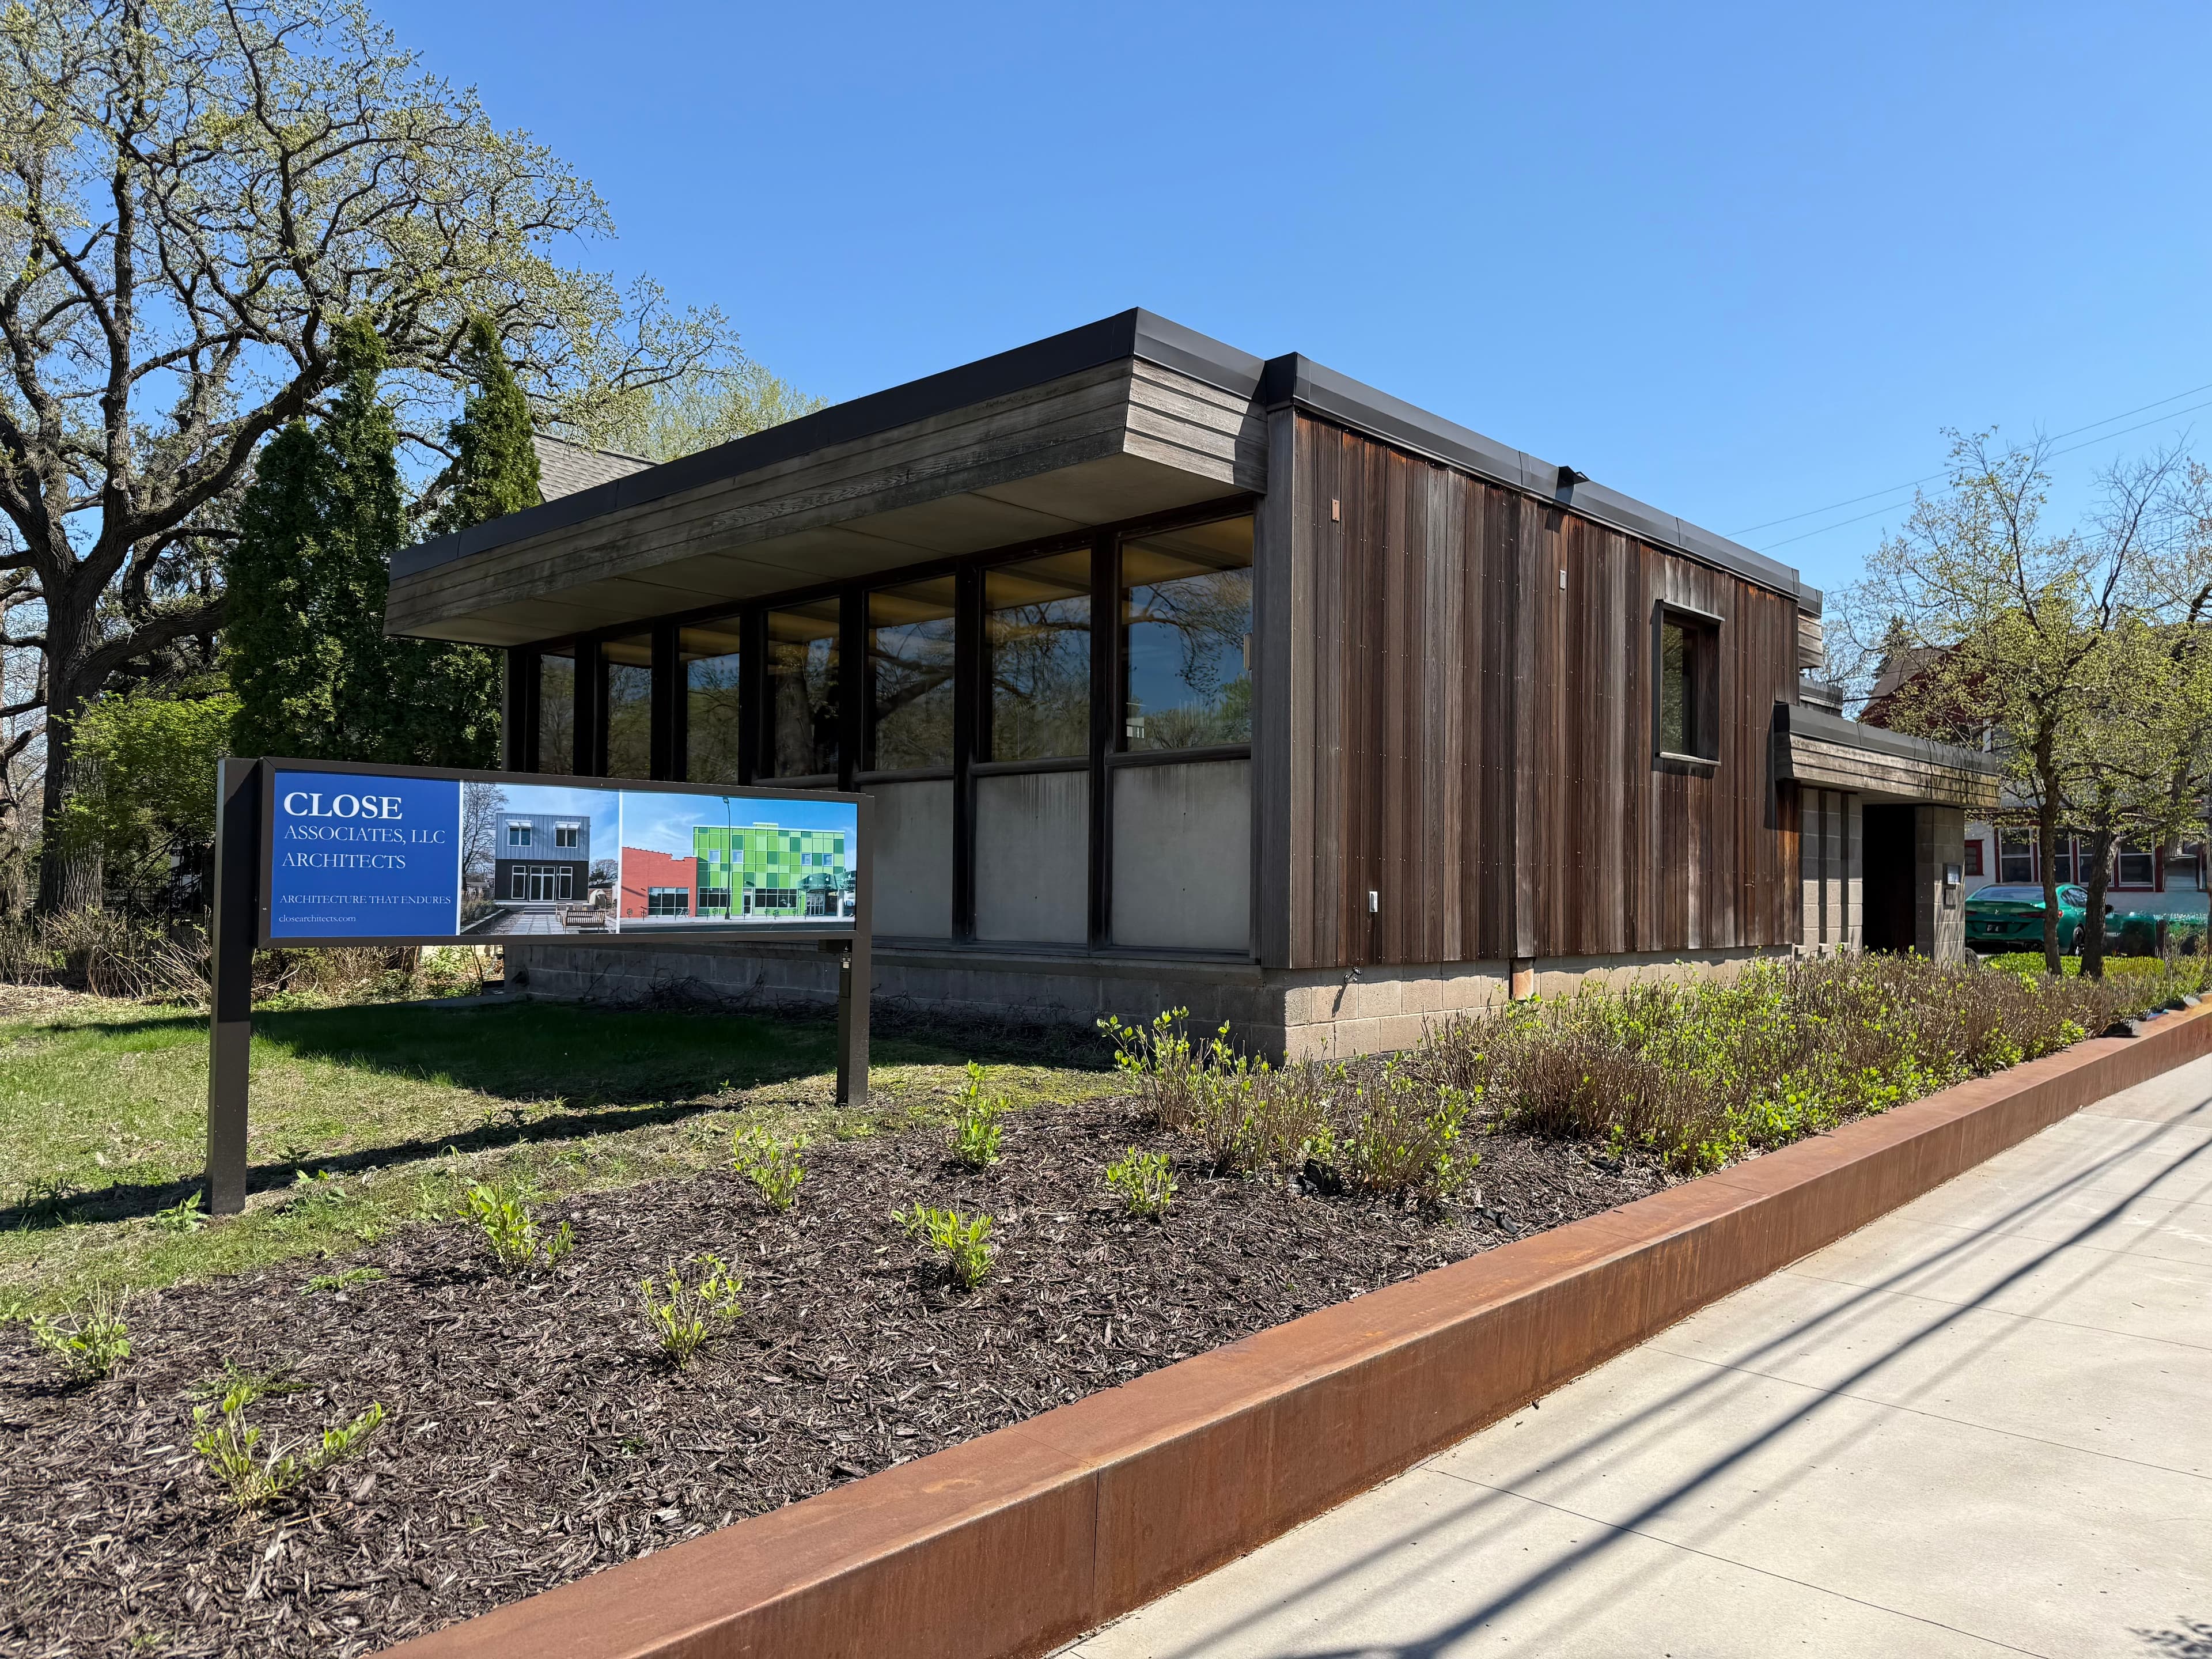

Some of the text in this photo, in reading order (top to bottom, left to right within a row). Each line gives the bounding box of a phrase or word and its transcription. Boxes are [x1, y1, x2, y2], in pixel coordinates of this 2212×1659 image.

[283, 791, 403, 820] CLOSE
[284, 825, 445, 846] ASSOCIATES, LLC
[282, 852, 406, 869] ARCHITECTS
[280, 895, 451, 904] ARCHITECTURE THAT ENDURES
